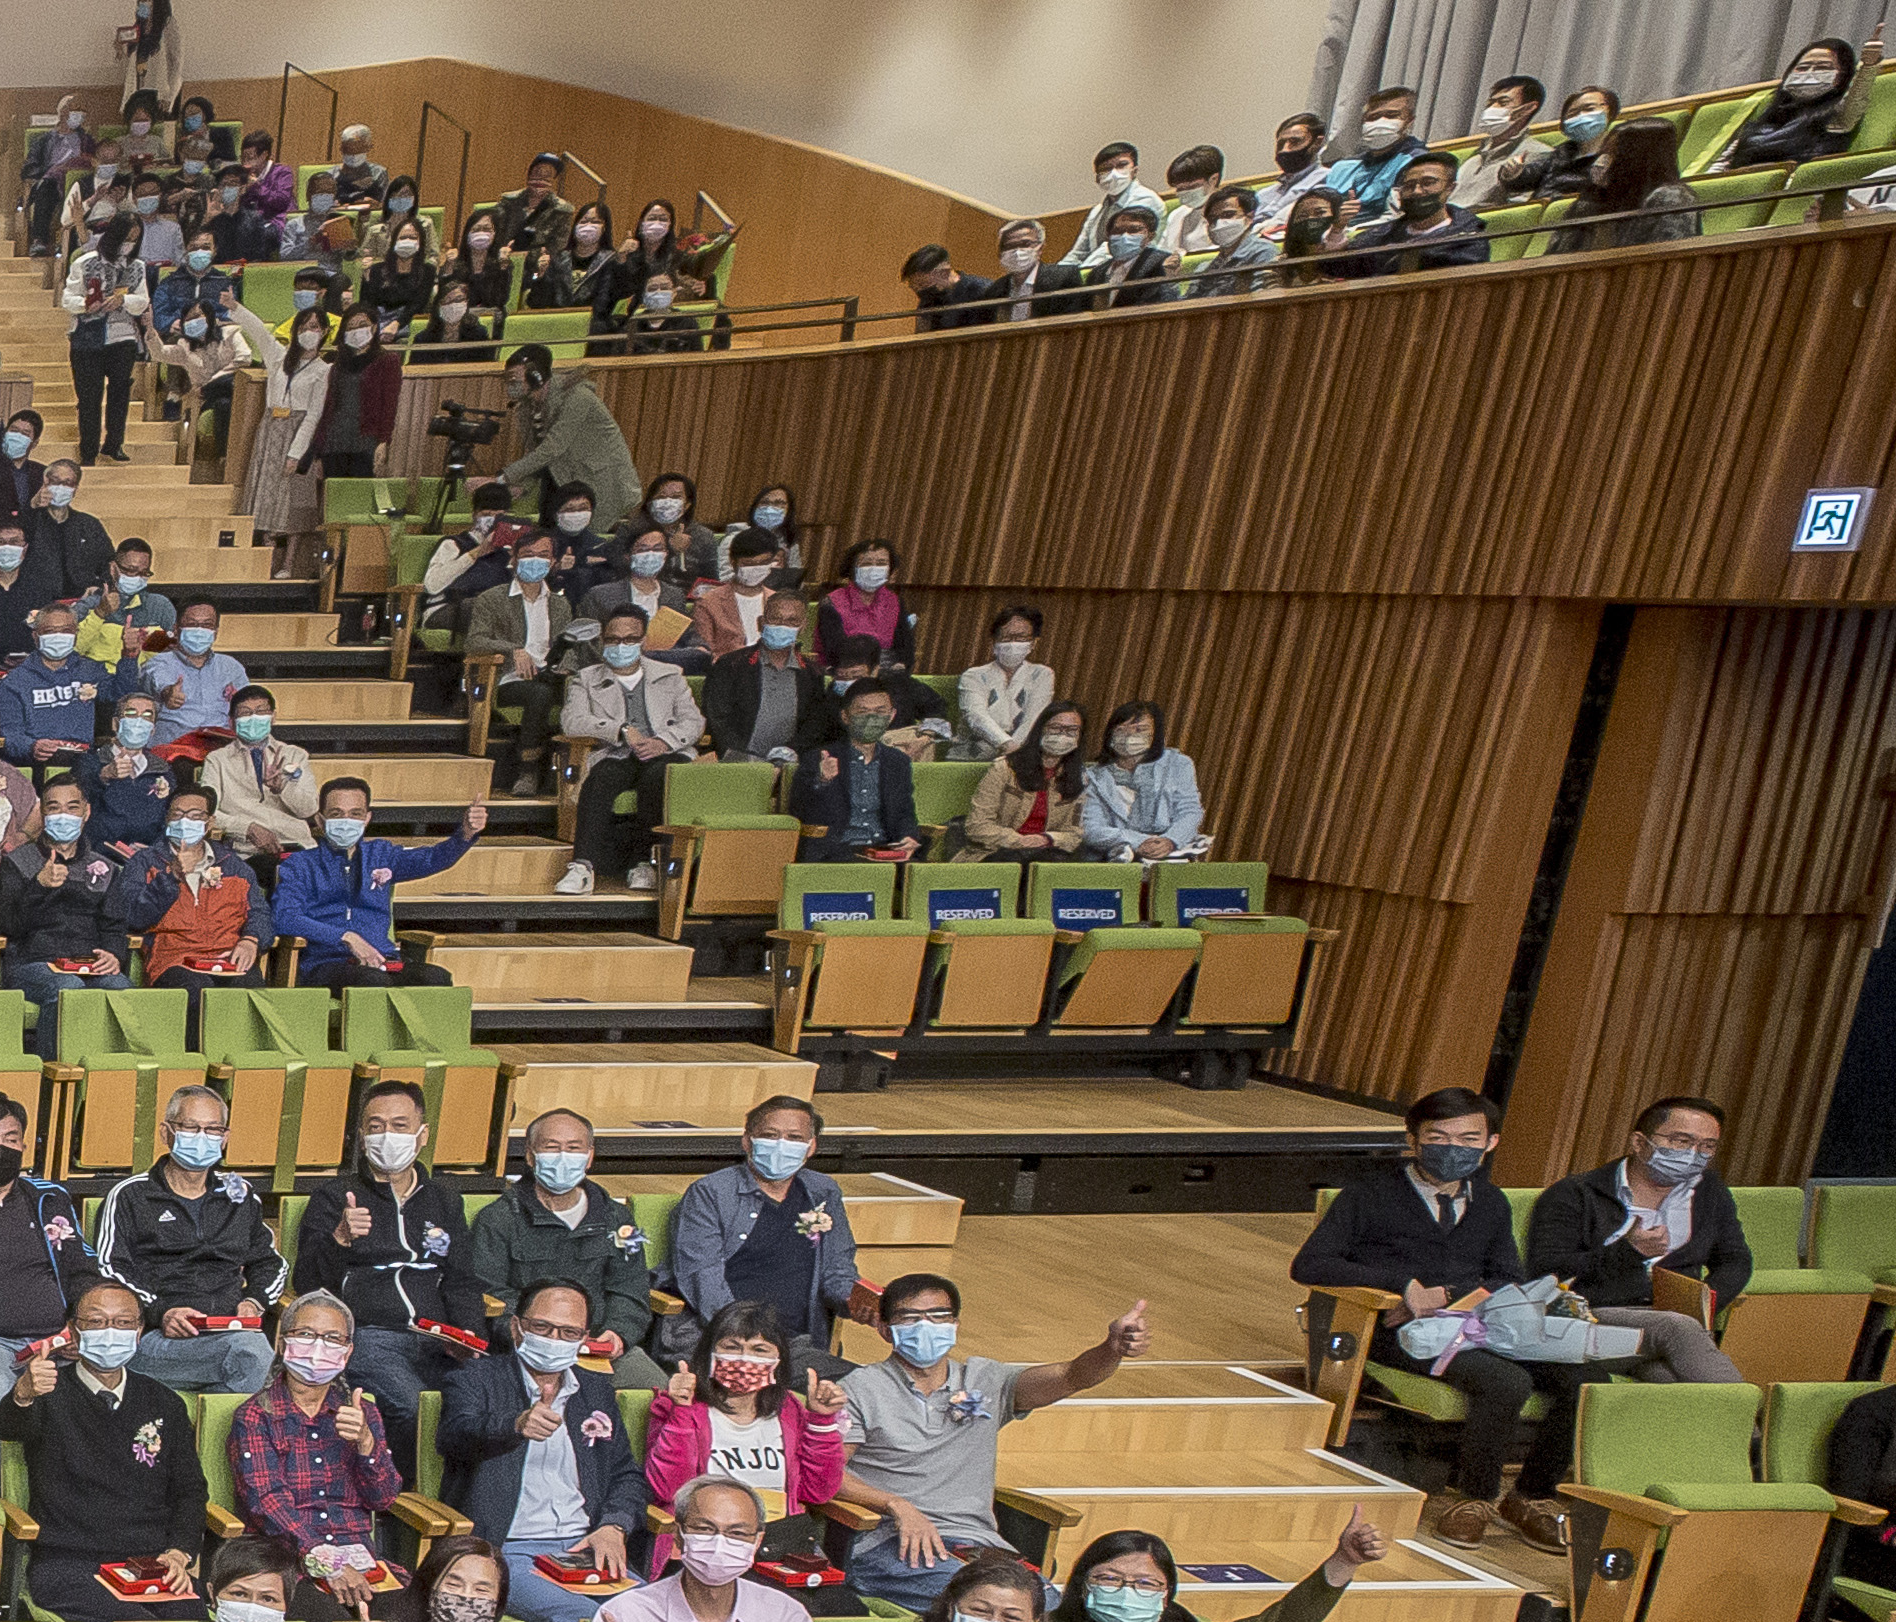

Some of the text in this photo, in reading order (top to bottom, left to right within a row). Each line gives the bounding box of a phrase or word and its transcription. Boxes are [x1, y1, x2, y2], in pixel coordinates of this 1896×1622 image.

[935, 908, 995, 920] RESERVED
[1058, 908, 1117, 919] RESERVED
[710, 1446, 784, 1470] NJO
